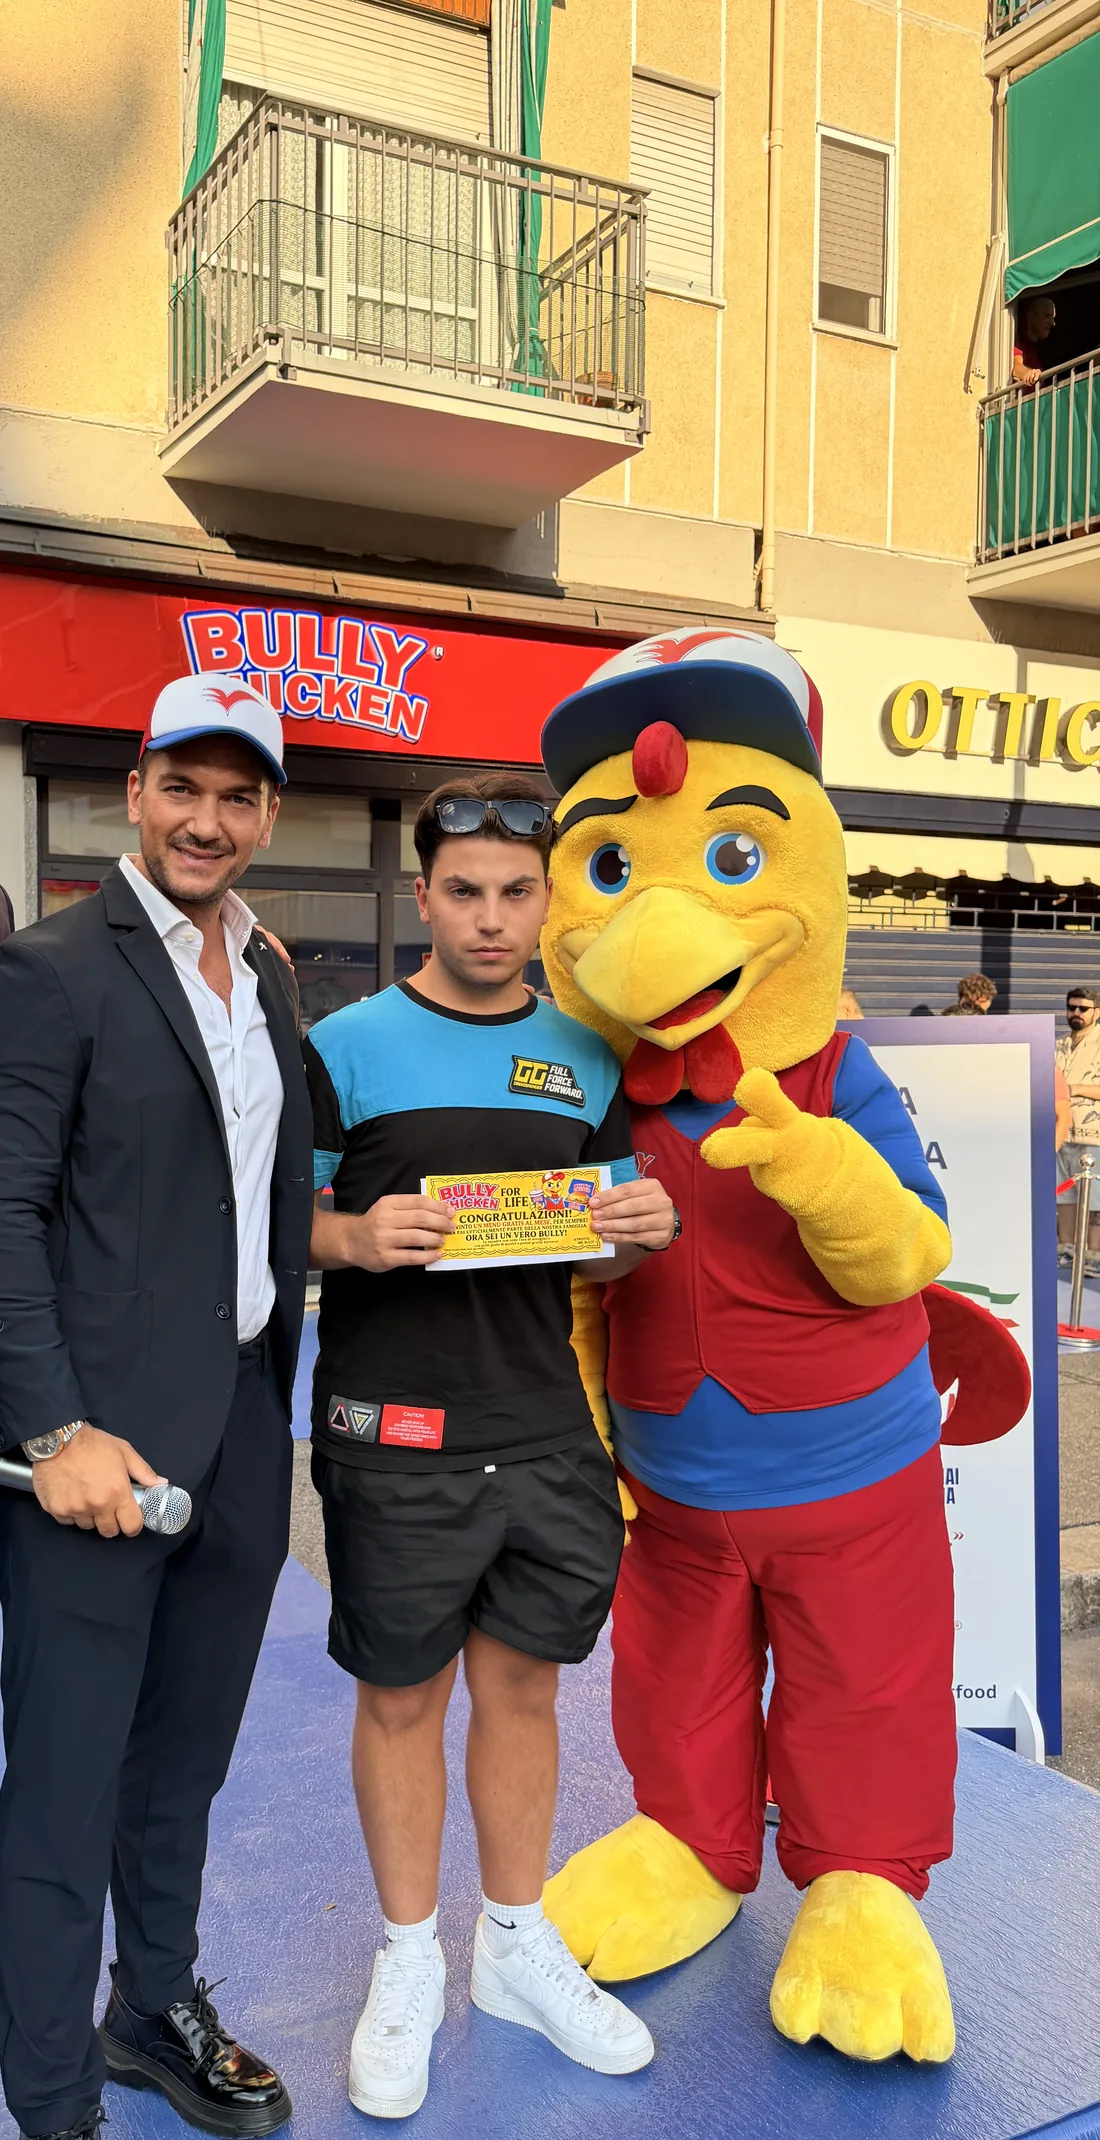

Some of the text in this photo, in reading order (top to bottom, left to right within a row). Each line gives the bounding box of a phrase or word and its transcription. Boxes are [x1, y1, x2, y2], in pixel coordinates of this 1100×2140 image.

[184, 609, 428, 691] BULLY
[549, 1065, 569, 1077] FULL
[546, 1074, 573, 1086] FORCE
[543, 1083, 583, 1100] FORWARD.
[438, 1182, 499, 1200] BULLY
[500, 1187, 520, 1197] FOR
[444, 1197, 500, 1211] HICKEN
[504, 1196, 529, 1208] LIFE
[459, 1209, 573, 1224] CONGRATULAZIONI!
[502, 1220, 525, 1228] GRATIS
[465, 1234, 484, 1242] ORA
[485, 1233, 498, 1241] SEI
[500, 1232, 512, 1240] UN
[513, 1230, 537, 1239] VERO
[538, 1229, 568, 1238] BULLY!
